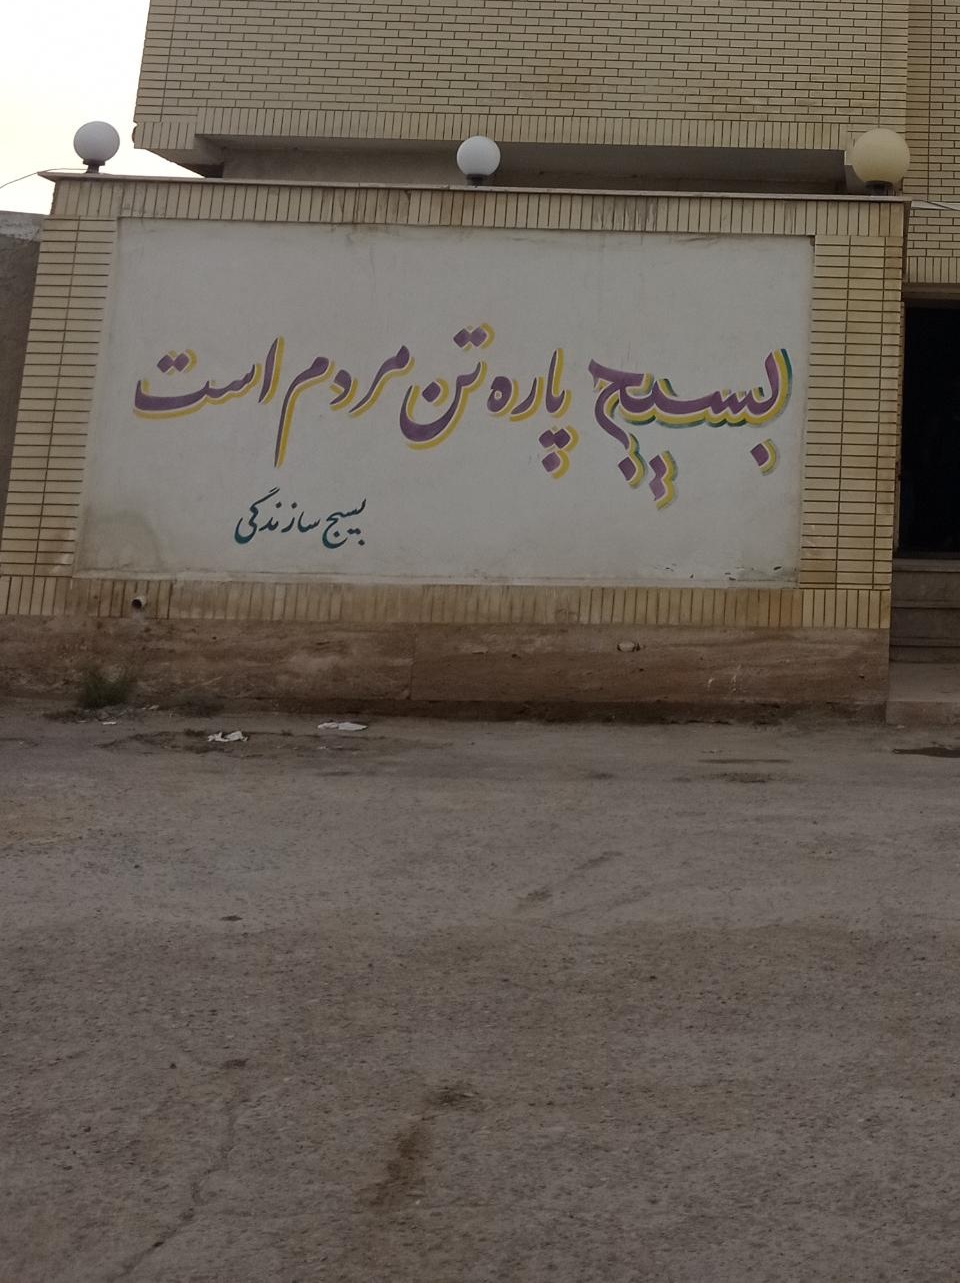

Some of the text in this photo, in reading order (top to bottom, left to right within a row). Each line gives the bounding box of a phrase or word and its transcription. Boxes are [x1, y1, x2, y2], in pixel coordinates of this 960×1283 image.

[133, 322, 794, 510] بسیج پاره تن مردم است
[233, 486, 367, 550] بسیج سازندگی
